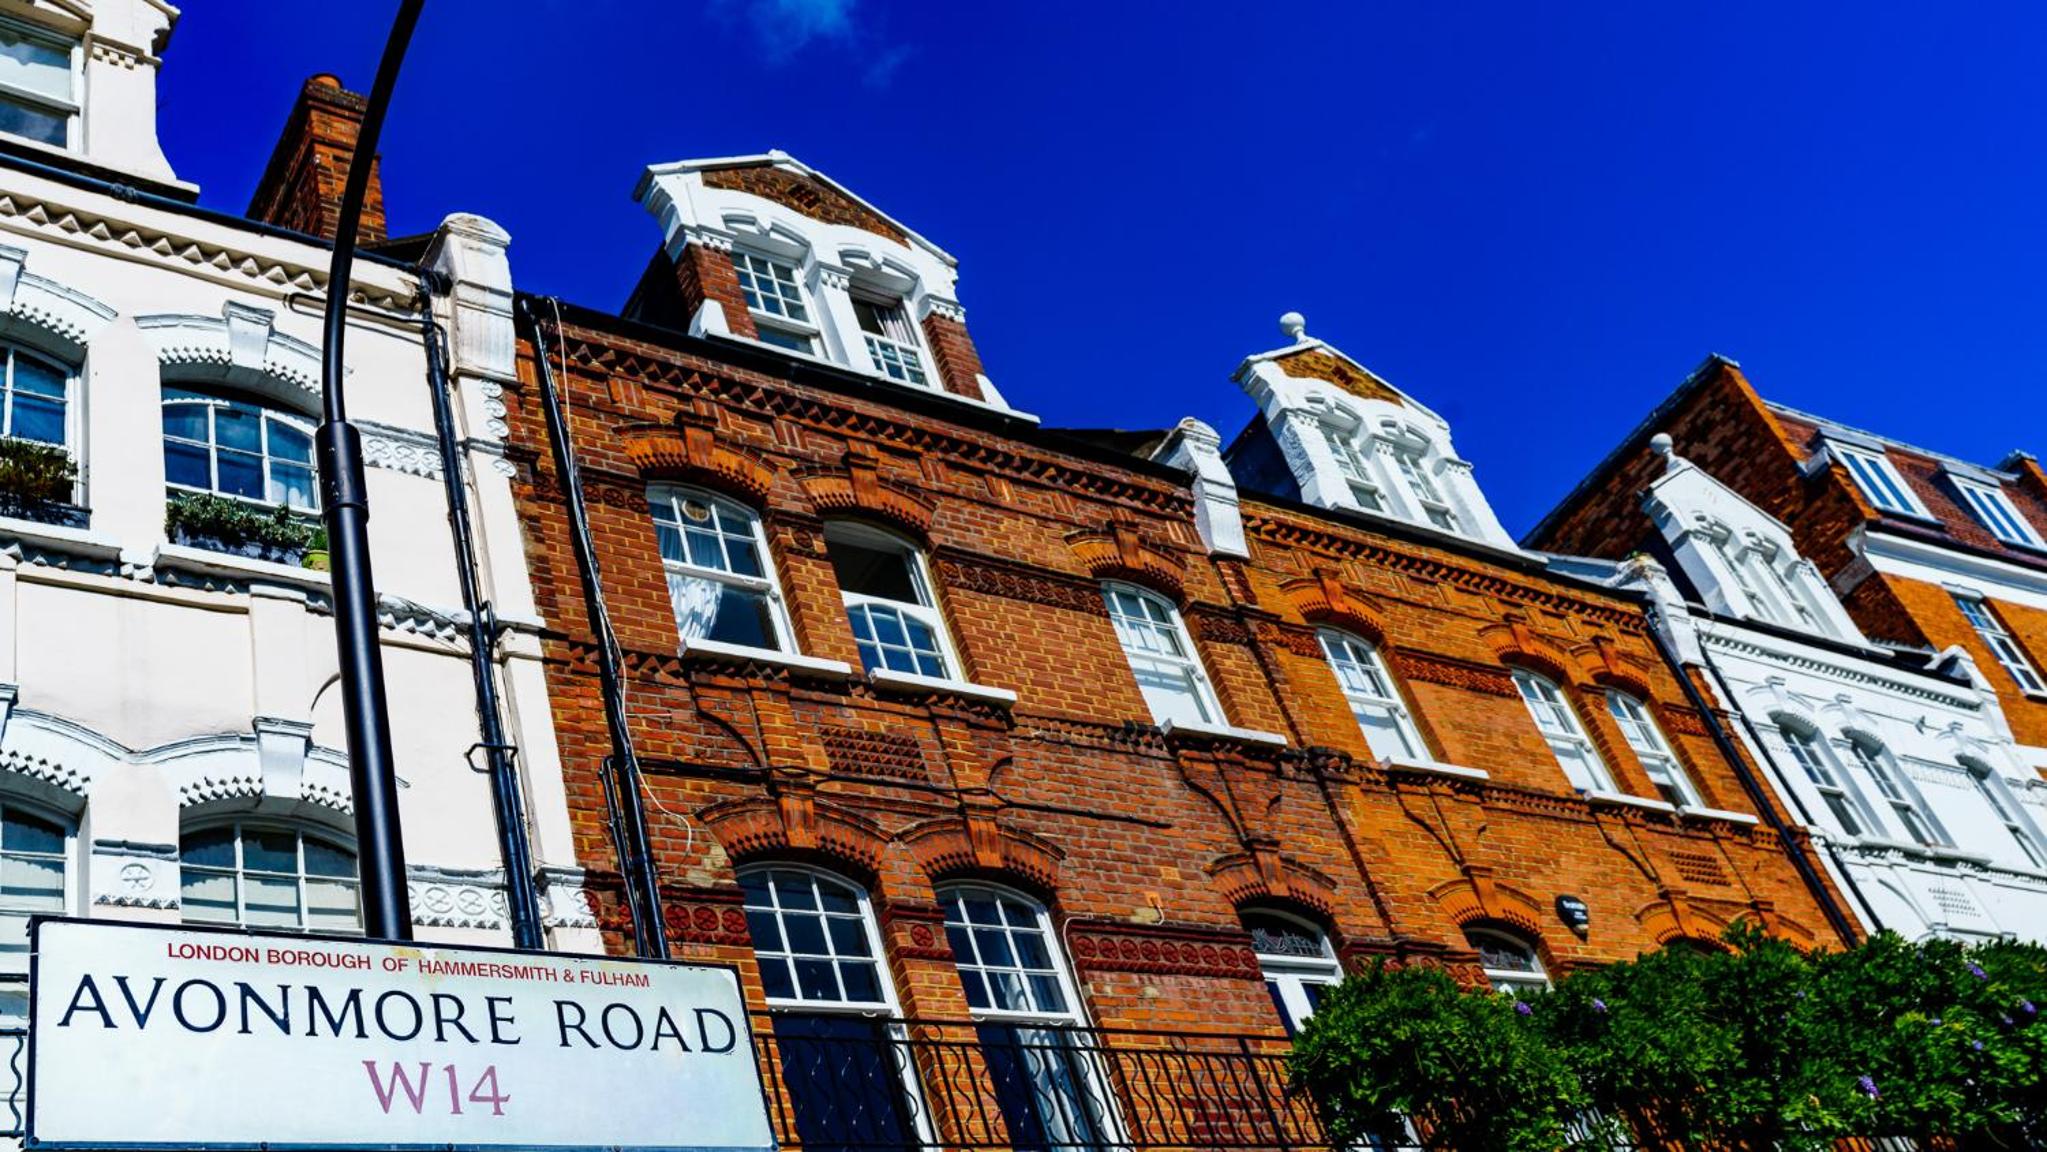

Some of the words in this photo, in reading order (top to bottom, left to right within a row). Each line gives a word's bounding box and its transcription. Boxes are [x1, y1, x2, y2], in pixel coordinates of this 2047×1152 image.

[167, 942, 260, 963] LONDON
[267, 949, 372, 970] BOROUGH
[382, 957, 409, 972] OF
[418, 959, 558, 983] HAMMERSMITH
[563, 968, 576, 983] &
[580, 970, 651, 988] FULHAM
[57, 973, 521, 1046] AVONMORE
[553, 999, 737, 1054] ROAD
[362, 1060, 511, 1117] W14
